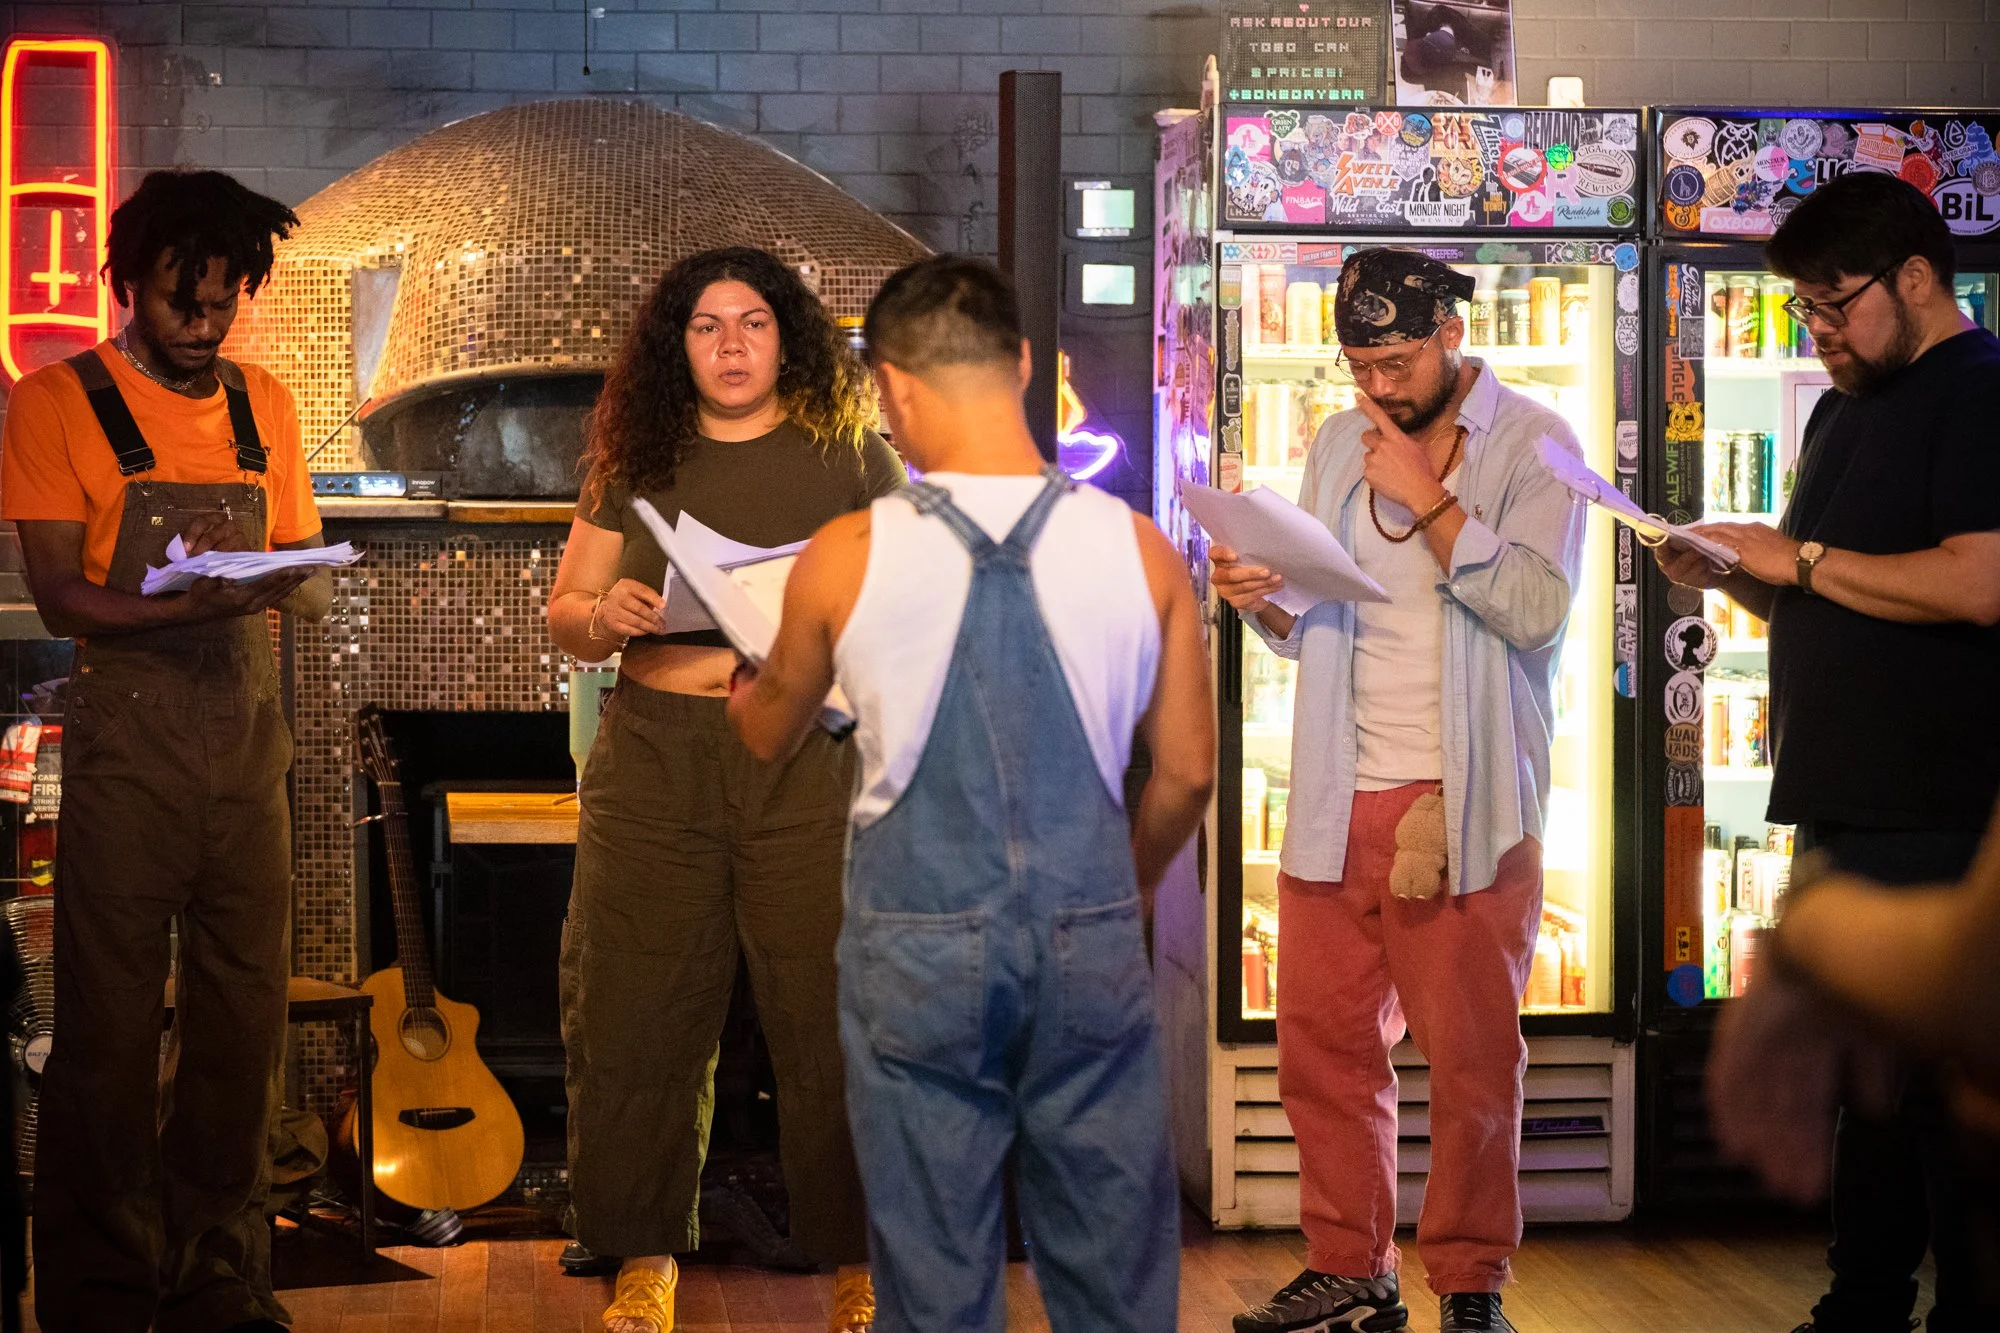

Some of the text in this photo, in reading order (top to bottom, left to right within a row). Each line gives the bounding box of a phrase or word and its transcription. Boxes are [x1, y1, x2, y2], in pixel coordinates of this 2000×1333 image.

[1230, 17, 1371, 27] ASK ABOUT OUR
[1314, 42, 1349, 52] CAN
[1267, 67, 1343, 77] PRICES!
[1607, 148, 1627, 165] CITY
[1943, 144, 1978, 159] EVER GRAIN
[1334, 177, 1399, 196] AVENUE
[1578, 178, 1622, 194] REWING
[1286, 196, 1323, 205] FINBACK
[1330, 192, 1405, 216] Wild East
[1942, 192, 1994, 222] BiL
[1409, 203, 1466, 217] MONDAY NIGHT
[1556, 205, 1600, 220] Randolph
[1709, 216, 1769, 230] OXBOW
[37, 774, 58, 782] CASE
